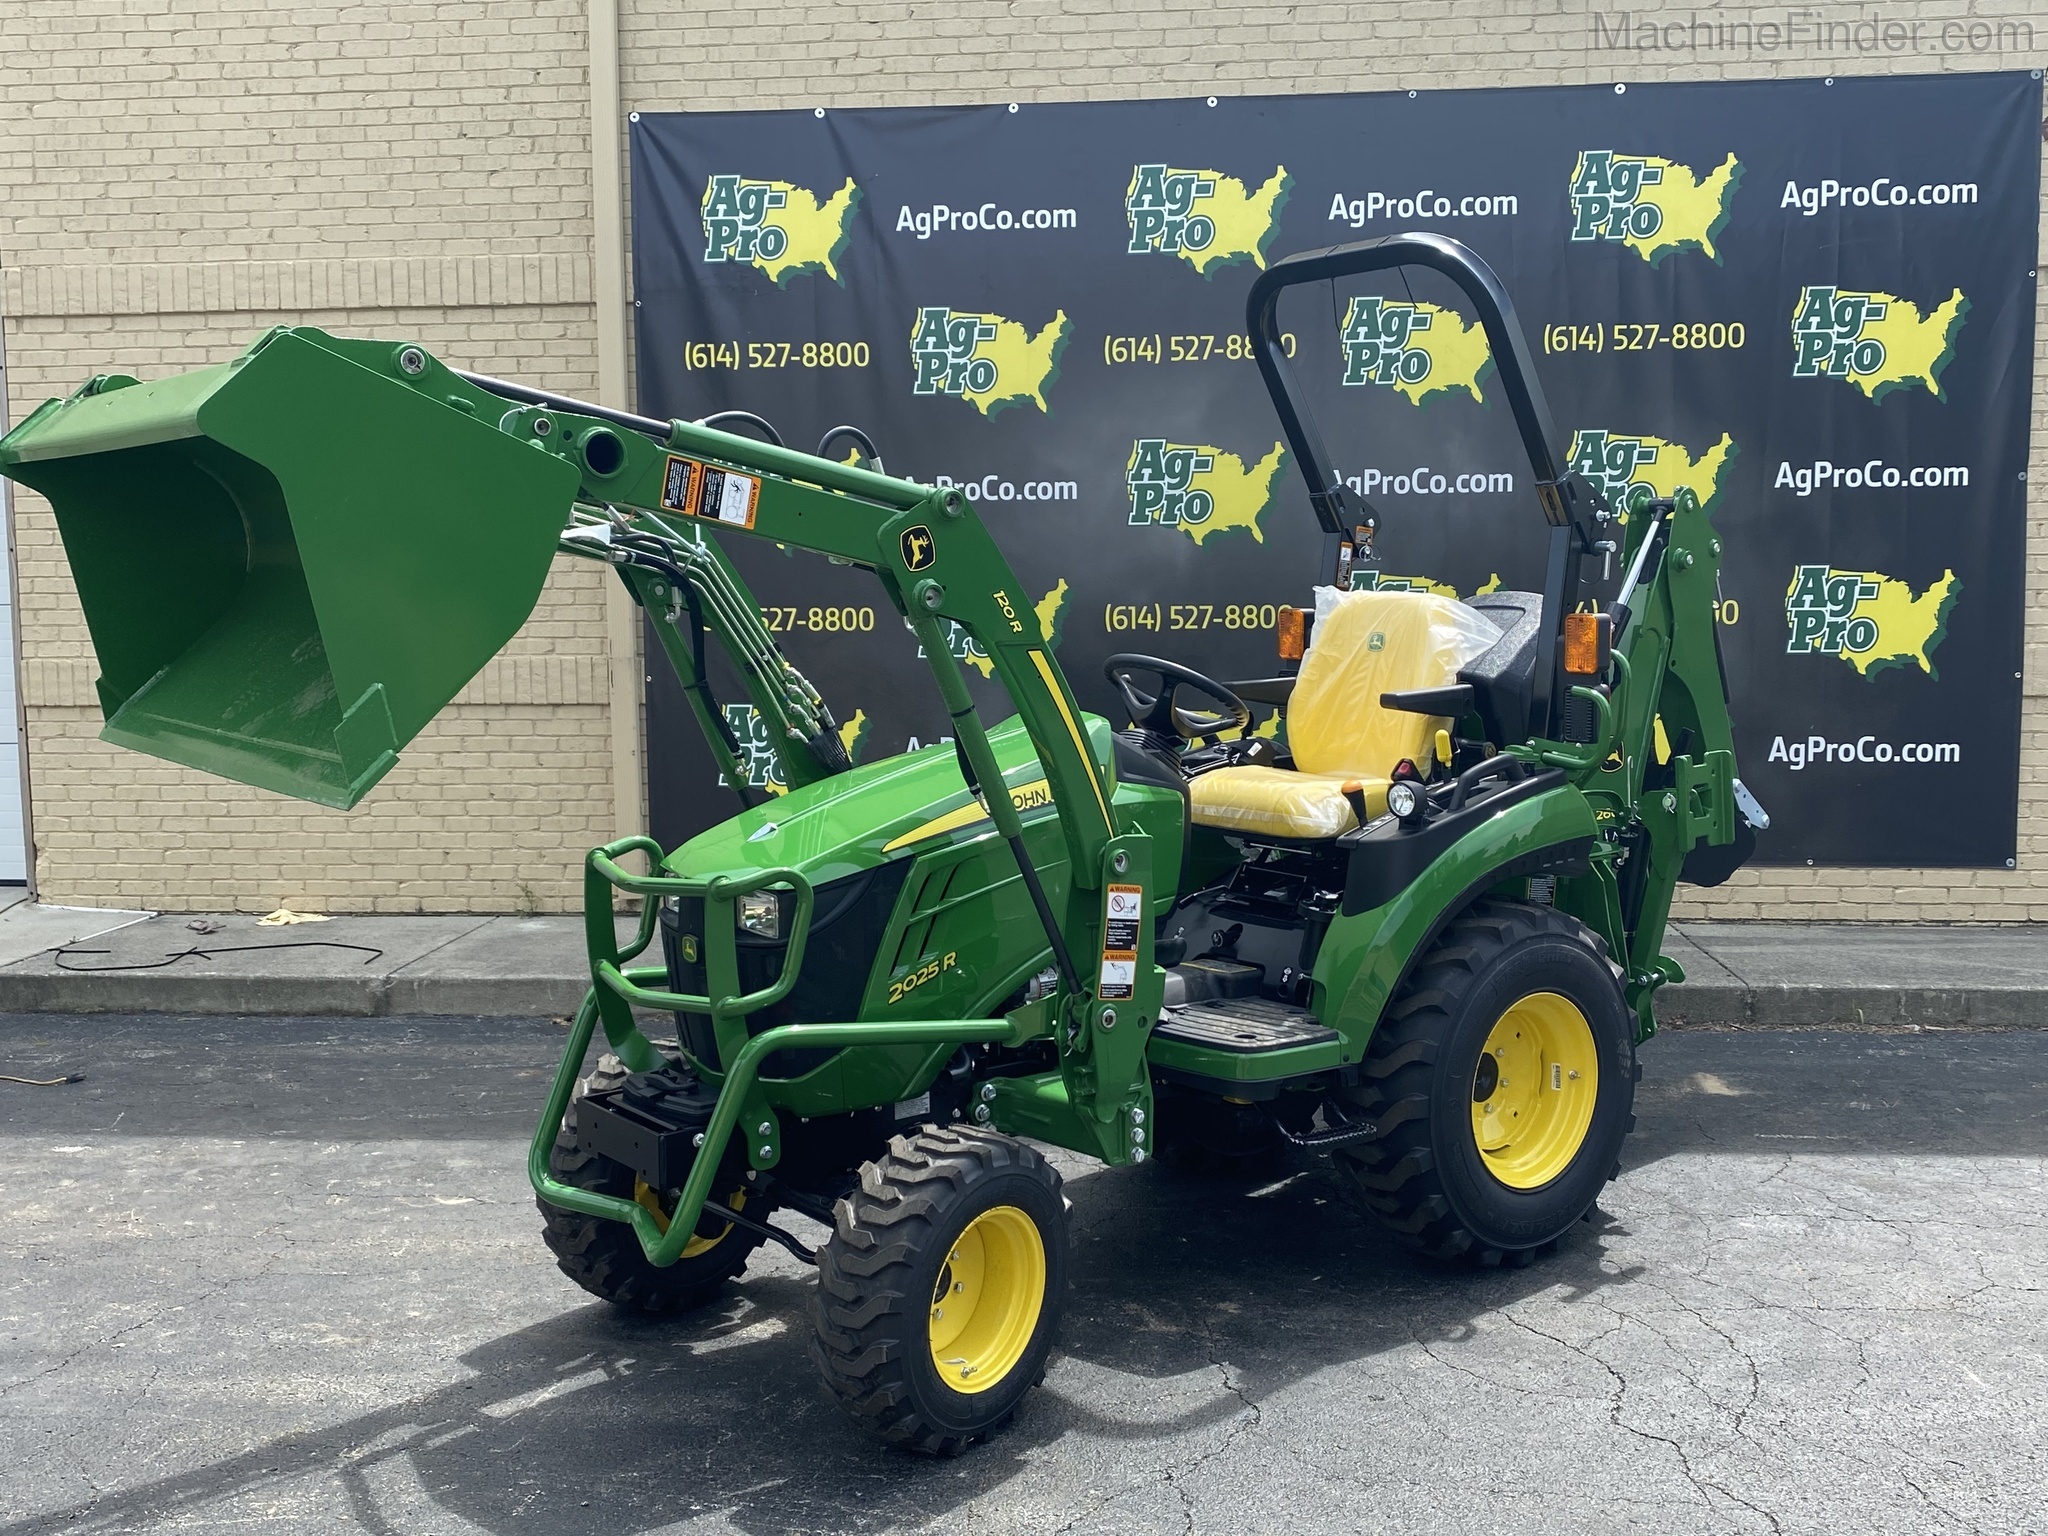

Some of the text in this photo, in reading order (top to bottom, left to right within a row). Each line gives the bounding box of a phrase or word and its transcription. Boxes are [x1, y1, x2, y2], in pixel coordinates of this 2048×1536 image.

[1128, 164, 1214, 219] Ag-
[1572, 149, 1662, 205] Ag-
[1780, 177, 1978, 216] AgProCo.com
[703, 175, 787, 228] Ag-
[895, 203, 1077, 240] AgProCo.com
[1328, 190, 1518, 228] AgProCo.com
[1571, 194, 1662, 240] Pro
[704, 218, 788, 262] Pro
[1127, 208, 1214, 253] Pro
[912, 307, 997, 361] Ag-
[1342, 296, 1432, 351] Ag-
[1793, 285, 1887, 341] Ag-
[684, 342, 870, 370] (614) 527-8800
[1104, 333, 1297, 364] (614) 527-880
[1544, 322, 1745, 353] (614) 527-8800
[1793, 331, 1885, 376] Pro
[913, 350, 997, 394] Pro
[1342, 341, 1431, 385] Pro
[1127, 438, 1213, 492] Ag-
[1568, 429, 1657, 484] Ag-
[1774, 459, 1969, 497] AgProCo.com
[1127, 480, 1213, 525] Pro
[1787, 564, 1879, 619] Ag-
[1105, 603, 1292, 632] (614) 527-880
[1786, 609, 1878, 653] Pro
[1767, 734, 1960, 771] AgProCo.com
[1012, 788, 1047, 809] OHN
[1114, 885, 1141, 893] WARNING
[1109, 953, 1136, 961] WARNING
